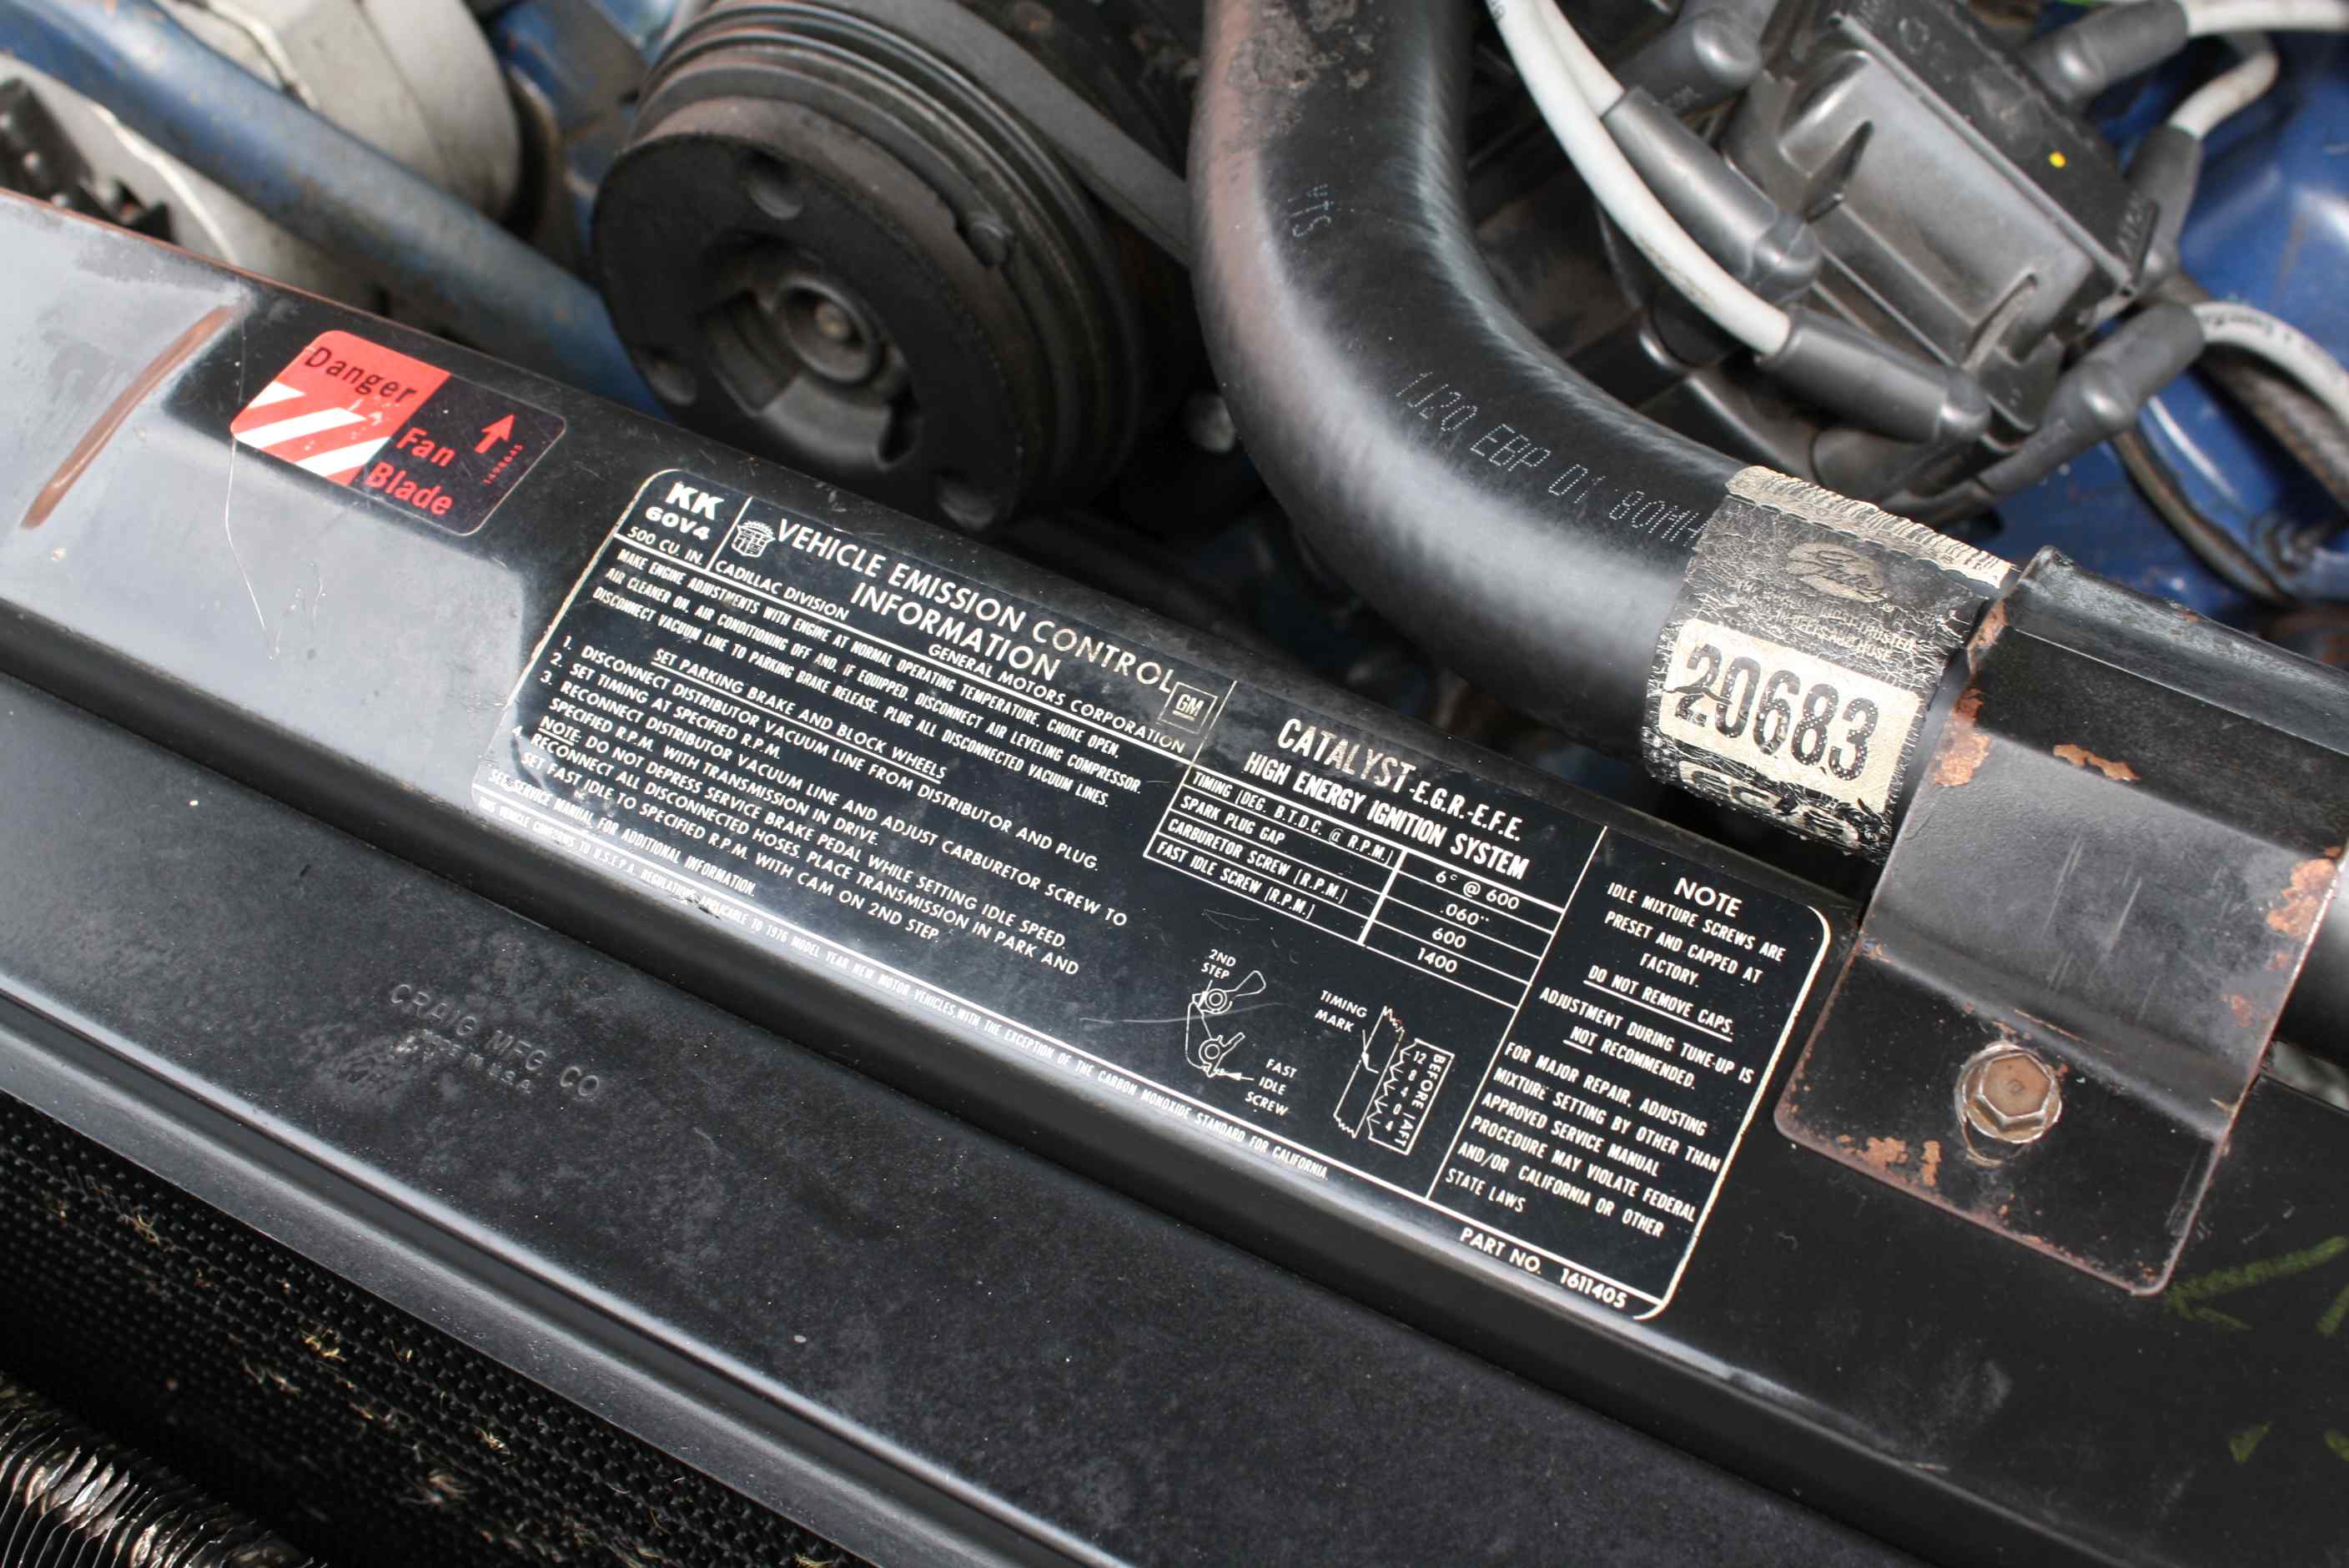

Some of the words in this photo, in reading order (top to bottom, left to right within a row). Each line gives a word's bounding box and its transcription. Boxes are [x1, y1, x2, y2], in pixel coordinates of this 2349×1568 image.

[304, 345, 418, 405] Danger
[395, 427, 457, 468] Fan
[364, 460, 455, 516] Blade
[665, 480, 725, 520] KK
[626, 525, 656, 545] 500
[658, 539, 682, 555] CU.
[684, 549, 704, 565] IN.
[644, 505, 712, 540] 60V4
[714, 560, 782, 594] CADILLAC
[783, 586, 849, 621] DIVISION
[770, 518, 886, 578] VEHICLE
[888, 562, 1027, 632] EMISSION
[1030, 619, 1177, 693] CONTROL
[648, 562, 686, 585] ENGINE
[687, 577, 760, 614] ADJUSTMENTS
[792, 618, 831, 641] ENGINE
[850, 641, 893, 666] NORMAL
[896, 659, 956, 691] OPERATING
[1046, 718, 1084, 742] CHOKE
[849, 582, 1061, 681] INFORMATION
[591, 586, 656, 621] DISCONNECT
[656, 614, 702, 641] VACUUM
[747, 651, 794, 678] PARKING
[795, 670, 831, 693] BRAKE
[831, 685, 880, 714] RELEASE.
[941, 729, 1024, 771] DISCONNECTED
[1027, 763, 1074, 791] VACUUM
[1074, 783, 1110, 807] LINES.
[596, 674, 649, 703] TIMING
[672, 706, 738, 740] SPECIFIED
[626, 577, 672, 603] CLEANER
[716, 613, 788, 651] CONDITIONING
[914, 692, 983, 728] DISCONNECT
[1009, 731, 1064, 761] LEVELING
[1066, 754, 1143, 793] COMPRESSOR.
[927, 643, 993, 677] GENERAL
[997, 671, 1066, 706] MOTORS
[1069, 699, 1185, 752] CORPORATION
[1174, 693, 1204, 718] GM
[1674, 643, 1879, 781] 20683
[581, 645, 671, 690] DISCONNECT
[672, 683, 760, 727] DISTRIBUTOR
[763, 720, 829, 756] VACUUM
[917, 784, 1013, 832] DISTRIBUTOR
[678, 659, 744, 694] PARKING
[747, 686, 795, 715] BRAKE
[835, 722, 888, 753] BLOCK
[890, 746, 948, 779] WHEELS
[548, 697, 613, 732] SPECIFIED
[701, 761, 810, 816] TRANSMISSION
[832, 817, 880, 845] DRIVE.
[560, 681, 644, 723] RECONNECT
[645, 716, 732, 761] DISTRIBUTOR
[736, 753, 803, 791] VACUUM
[880, 815, 938, 846] ADJUST
[940, 840, 1041, 890] CARBURETOR
[1044, 883, 1100, 914] SCREW
[531, 733, 614, 776] RECONNECT
[643, 781, 750, 835] DISCONNECTED
[752, 827, 802, 858] HOSES.
[805, 851, 853, 879] PLACE
[855, 872, 969, 929] TRANSMISSION
[638, 802, 706, 839] SPECIFIED
[1180, 795, 1221, 821] SPARK
[1223, 812, 1255, 834] PLUG
[1259, 826, 1285, 845] GAP
[1191, 771, 1233, 797] TIMING
[1273, 805, 1324, 835] B.T.D.C.
[1243, 751, 1291, 785] HIGH
[1292, 770, 1366, 814] ENERGY
[1366, 800, 1447, 847] IGNITION
[1449, 832, 1530, 879] SYSTEM
[552, 797, 596, 827] MANUAL
[621, 827, 682, 863] ADDITIONAL
[683, 854, 758, 896] INFORMATION.
[645, 761, 703, 793] DEPRESS
[704, 787, 762, 818] SERVICE
[763, 812, 814, 841] BRAKE
[816, 833, 863, 862] PEDAL
[867, 854, 913, 882] WHILE
[915, 876, 978, 910] SETTING
[1019, 919, 1067, 949] SPEED.
[1156, 841, 1188, 862] FAST
[1190, 855, 1217, 876] IDLE
[1219, 867, 1262, 894] SCREW
[1167, 818, 1243, 857] CARBURETOR
[1246, 850, 1290, 877] SCREW
[1486, 888, 1520, 910] 600
[1607, 882, 1637, 903] IDLE
[1641, 895, 1698, 927] MIXTURE
[1702, 919, 1755, 950] SCREWS
[1758, 941, 1786, 962] ARE
[1673, 877, 1742, 917] NOTE
[1208, 948, 1236, 967] 2ND
[1416, 947, 1457, 972] 1400
[1431, 927, 1466, 949] 600
[1604, 911, 1652, 938] PRESET
[1687, 943, 1738, 974] CAPPED
[1200, 962, 1230, 979] STEP
[1639, 952, 1700, 988] FACTORY.
[766, 925, 788, 942] 1976
[790, 936, 821, 957] MODEL
[825, 951, 849, 969] YEAR
[1003, 1029, 1054, 1059] EXCEPTION
[1097, 1070, 1137, 1095] CARBON
[1140, 1089, 1191, 1118] MONOXIDE
[1194, 1113, 1245, 1142] STANDARD
[1315, 1008, 1354, 1032] MARK
[1320, 990, 1368, 1018] TIMING
[1539, 987, 1622, 1029] ADJUSTMENT
[1626, 1021, 1675, 1051] DURING
[1679, 1043, 1735, 1075] TUNE-UP
[1611, 974, 1638, 994] NOT
[1641, 986, 1693, 1017] REMOVE
[1697, 1008, 1735, 1035] CAPS.
[560, 1066, 600, 1097] CO
[1259, 1076, 1285, 1095] IDLE
[1265, 1058, 1296, 1078] FAST
[1411, 1053, 1446, 1108] BEFORE
[1569, 1026, 1597, 1047] NOT
[1600, 1038, 1697, 1089] RECOMMENDED.
[1245, 1091, 1288, 1116] SCREW
[1492, 1067, 1549, 1100] MIXTURE
[1552, 1091, 1607, 1124] SETTING
[1635, 1126, 1679, 1155] OTHER
[1683, 1145, 1721, 1172] THAN
[1535, 1054, 1579, 1083] MAJOR
[1638, 1098, 1708, 1136] ADJUSTING
[1481, 1092, 1547, 1128] APPROVED
[1550, 1120, 1604, 1153] SERVICE
[1607, 1143, 1660, 1176] MANUAL
[1445, 1168, 1485, 1195] STATE
[1487, 1186, 1526, 1212] LAWS
[1457, 1141, 1509, 1173] AND/OR
[1517, 1164, 1592, 1206] CALIFORNIA
[1621, 1208, 1664, 1237] OTHER
[1470, 1115, 1547, 1158] PROCEDURE
[1586, 1163, 1639, 1197] VIOLATE
[1642, 1187, 1697, 1222] FEDERAL
[1460, 1227, 1506, 1256] PART
[1509, 1248, 1542, 1274] NO.
[1559, 1267, 1627, 1308] 1611405
